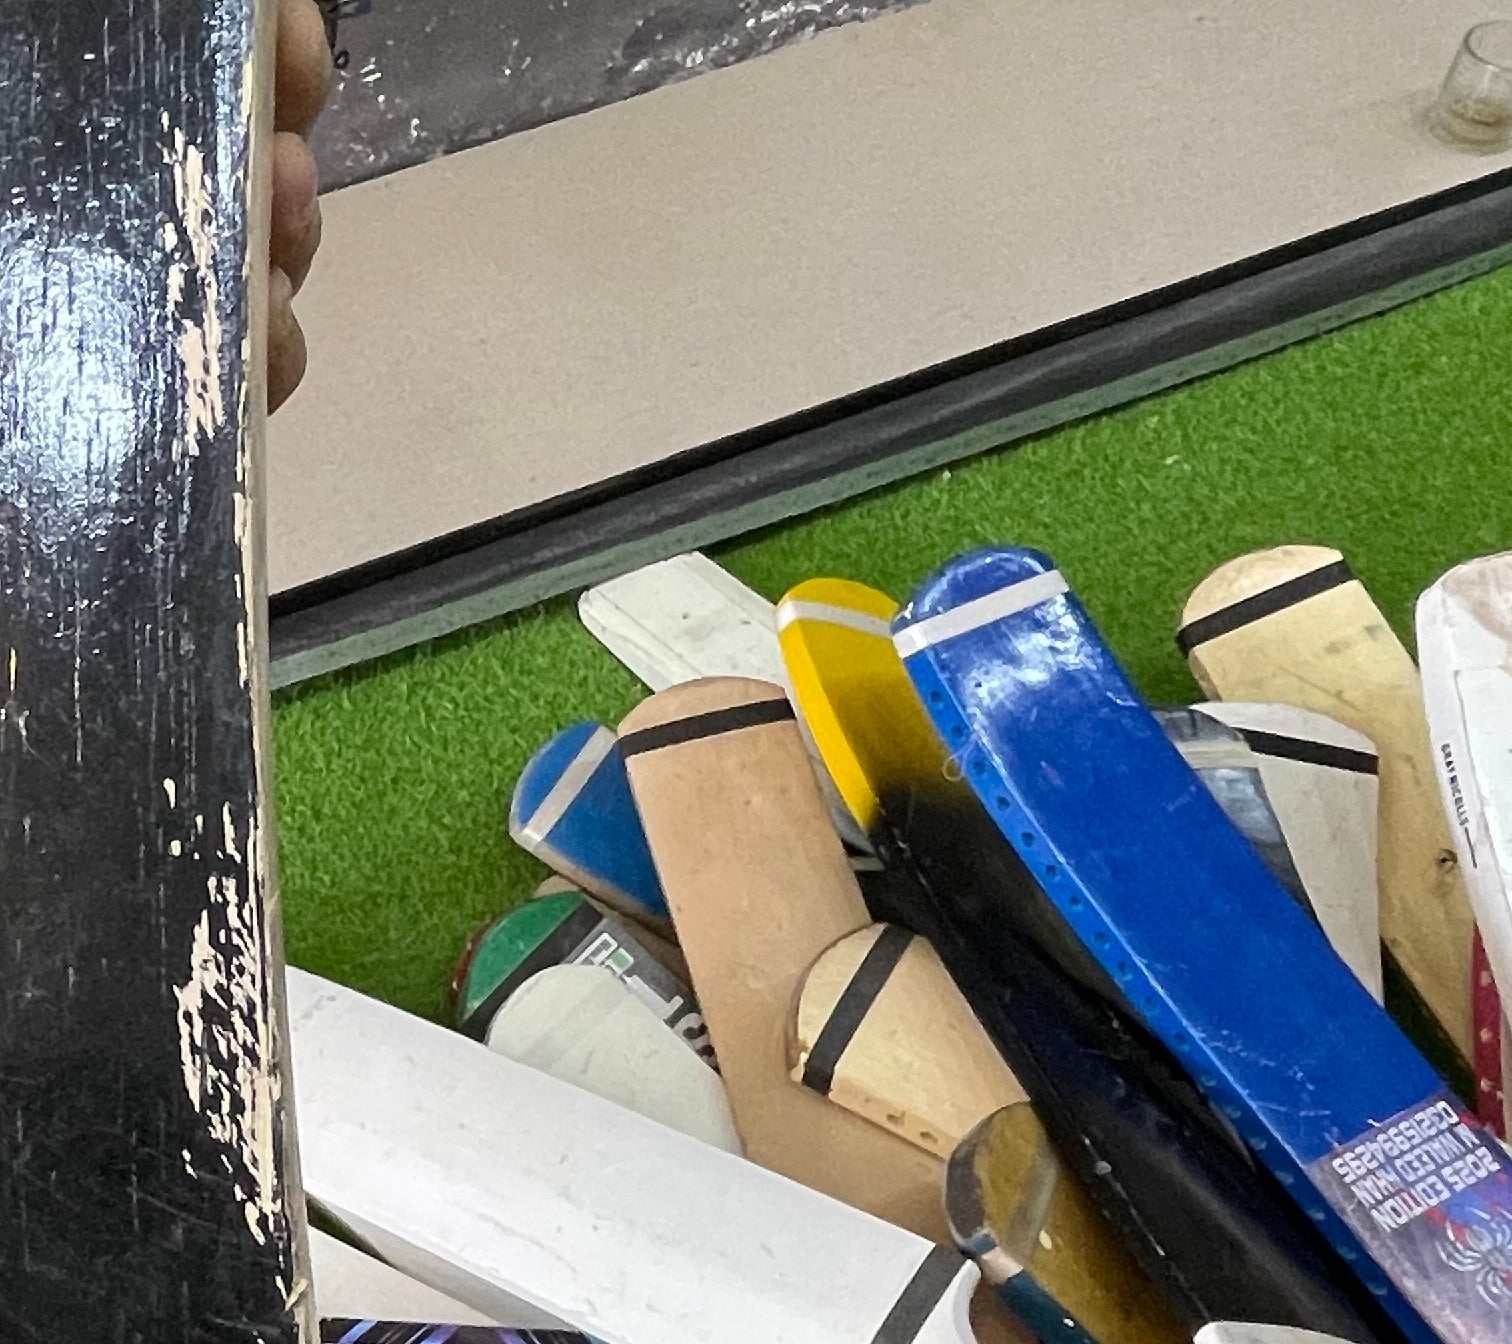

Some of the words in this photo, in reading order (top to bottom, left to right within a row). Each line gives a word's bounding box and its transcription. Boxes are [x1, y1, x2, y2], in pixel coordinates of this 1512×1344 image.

[1394, 1130, 1467, 1183] WALEED
[1440, 1146, 1501, 1192] 2025
[1369, 1173, 1451, 1233] EDITION
